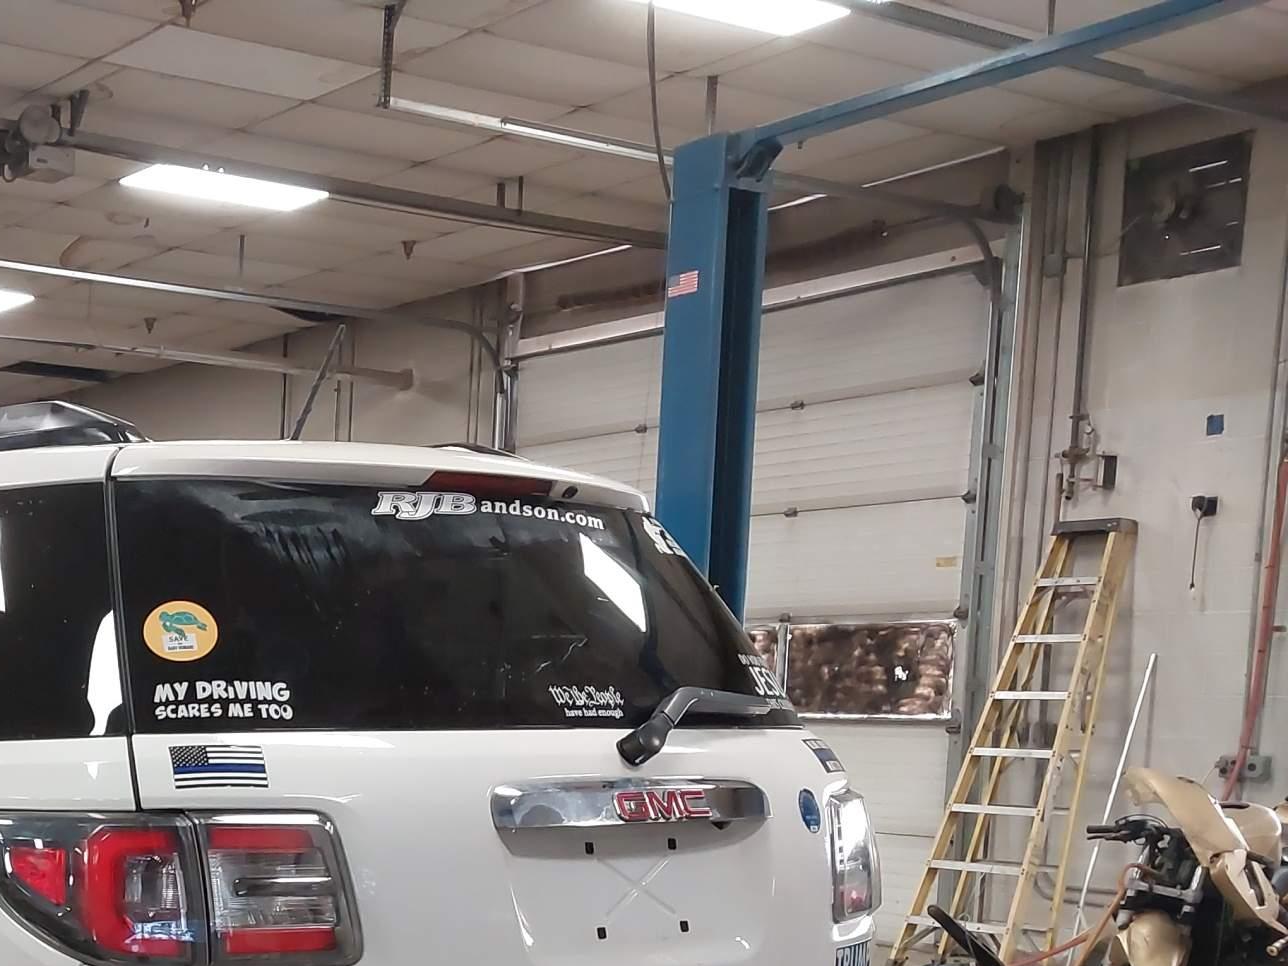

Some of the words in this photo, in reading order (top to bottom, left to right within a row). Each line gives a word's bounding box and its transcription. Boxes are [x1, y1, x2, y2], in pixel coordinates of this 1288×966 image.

[372, 491, 477, 520] RJB
[481, 500, 605, 530] andson.com
[154, 682, 189, 703] MY
[196, 680, 290, 701] DRIVING
[749, 666, 786, 697] JESU
[548, 685, 573, 706] We
[584, 686, 624, 708] People
[155, 703, 222, 719] SCARES
[228, 703, 254, 717] ME
[258, 704, 293, 719] TOO
[564, 708, 583, 717] have
[583, 707, 597, 717] had
[598, 708, 624, 719] enough
[614, 789, 712, 821] GMC
